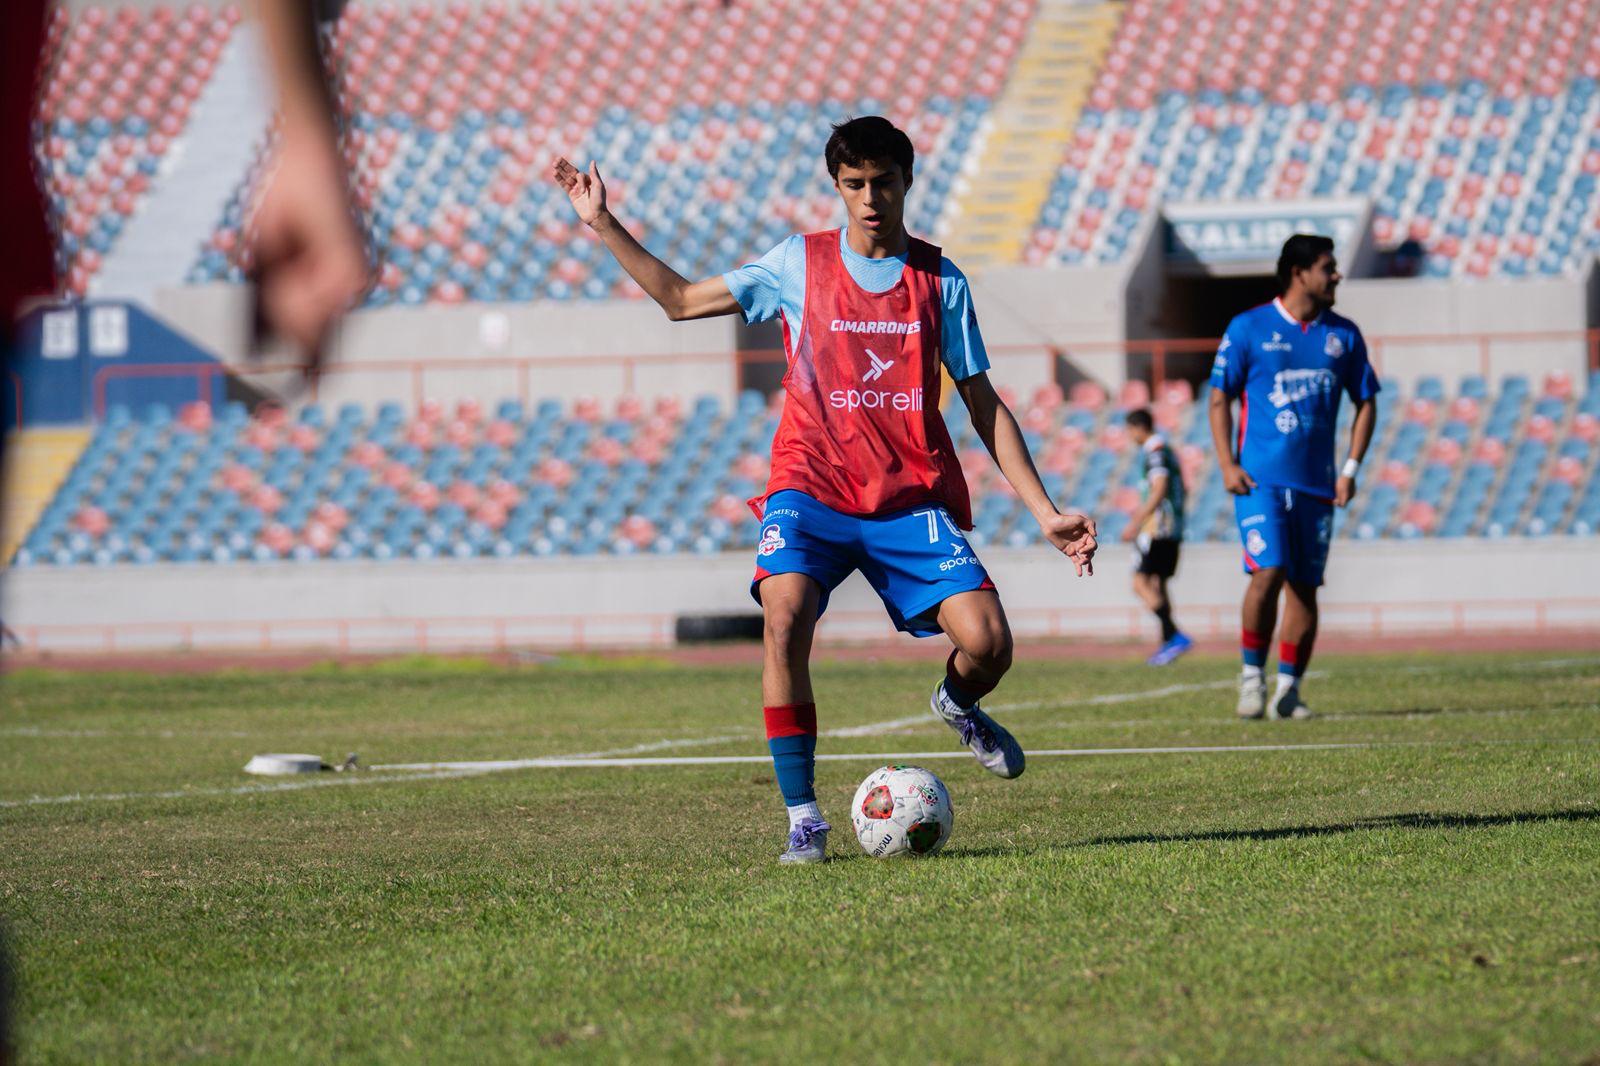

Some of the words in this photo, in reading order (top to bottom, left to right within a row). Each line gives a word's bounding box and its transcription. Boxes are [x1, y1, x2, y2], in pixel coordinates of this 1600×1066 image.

[830, 319, 922, 335] CIMARRONES
[829, 387, 923, 413] sporelli
[939, 556, 980, 571] spore
[872, 833, 893, 857] molte
